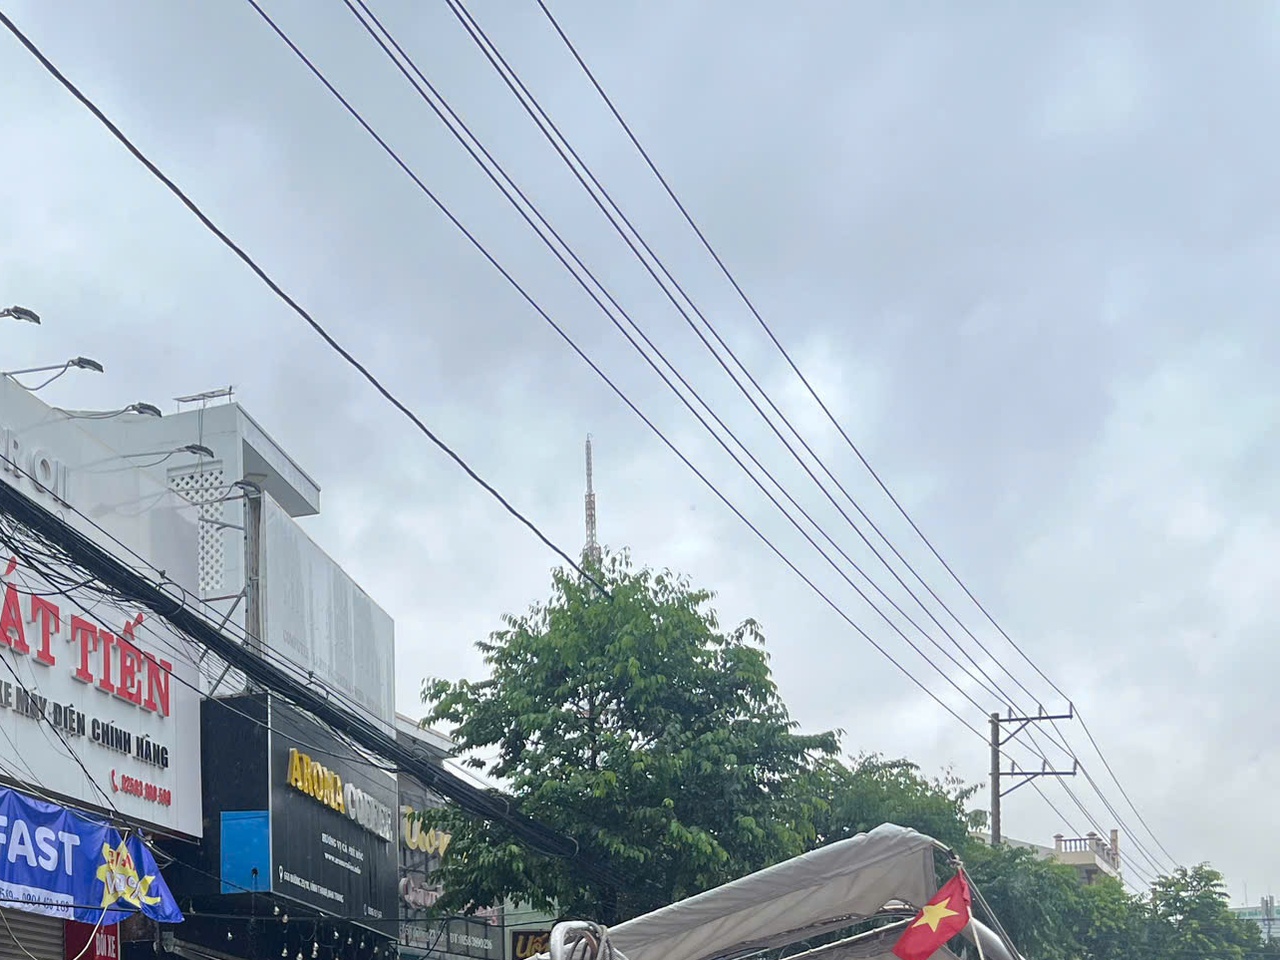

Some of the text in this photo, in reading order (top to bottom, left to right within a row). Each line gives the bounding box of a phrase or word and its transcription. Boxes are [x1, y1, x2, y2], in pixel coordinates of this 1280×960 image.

[70, 612, 172, 718] TIẾN
[91, 720, 132, 755] CHÍNH
[134, 734, 169, 768] HÃNG
[287, 748, 346, 814] AROMA
[107, 934, 116, 958] XE
